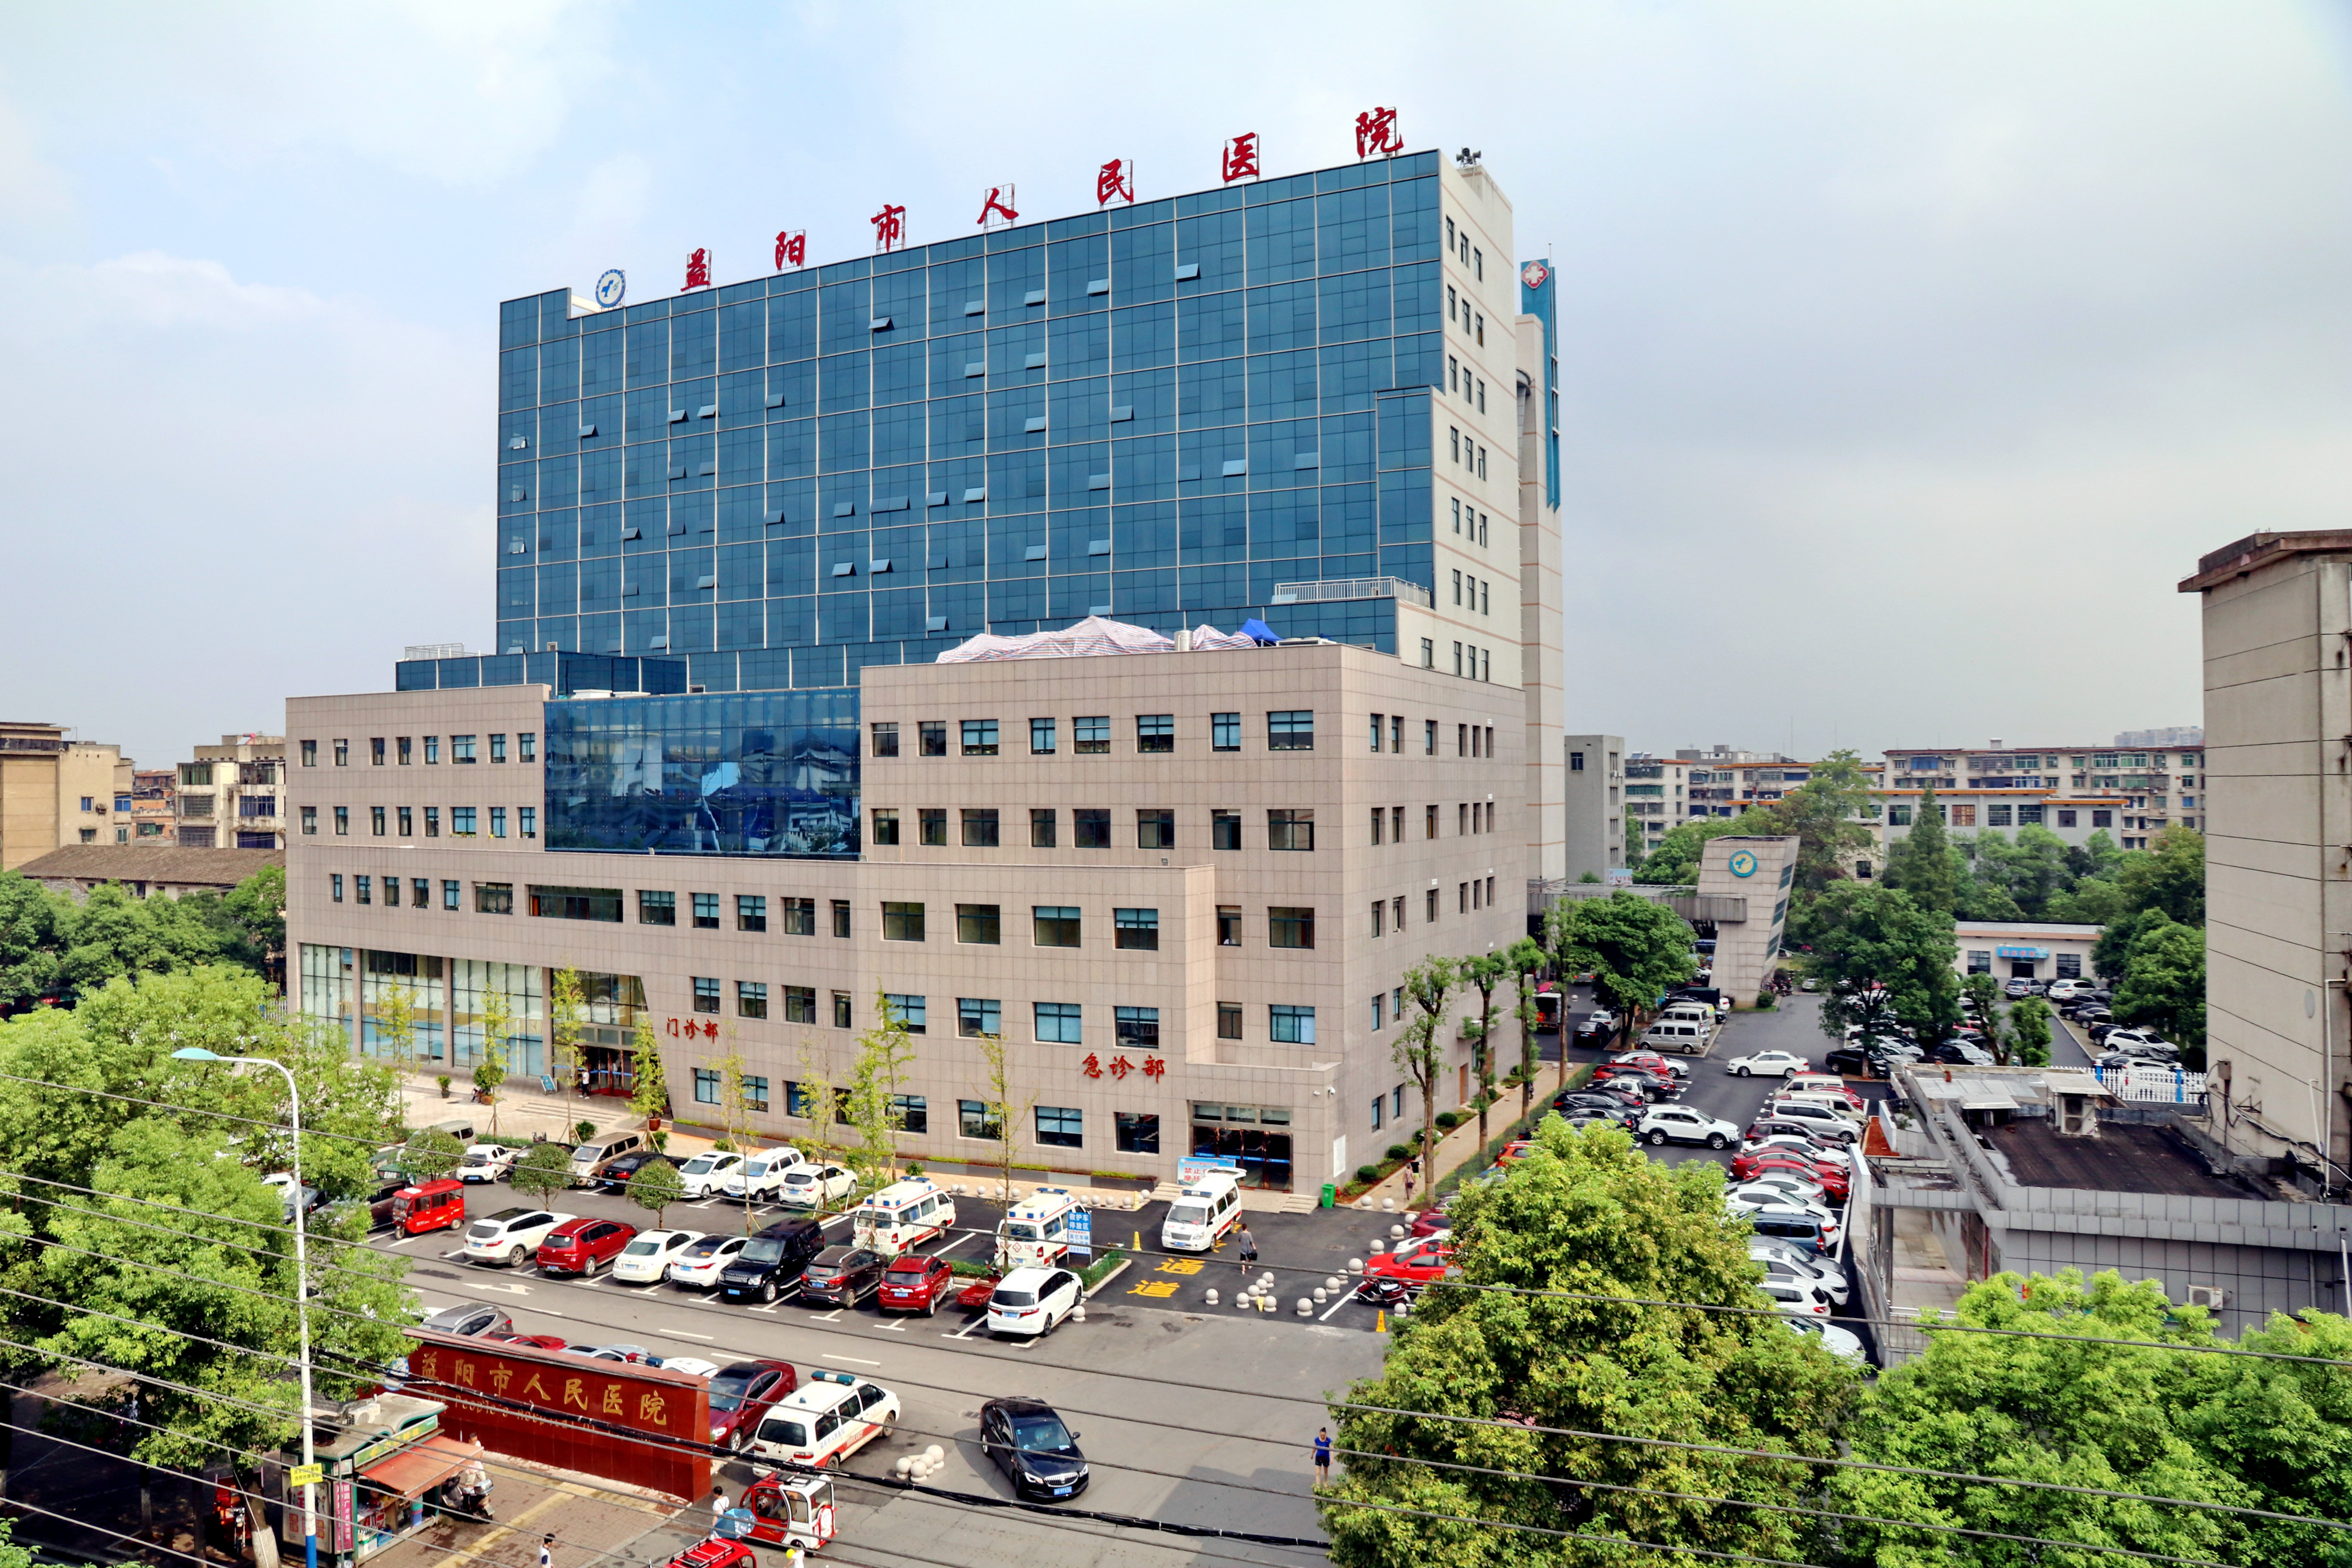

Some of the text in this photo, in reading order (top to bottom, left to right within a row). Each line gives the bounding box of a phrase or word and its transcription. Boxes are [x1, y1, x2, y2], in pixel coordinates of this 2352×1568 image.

[682, 107, 1403, 291] 益阳市人民医院
[667, 1017, 718, 1043] 门诊部
[1082, 1052, 1165, 1083] 急诊部
[1069, 1213, 1089, 1222] 救护车
[1069, 1221, 1089, 1230] 停放区
[422, 1352, 667, 1426] 益阳市人民医院
